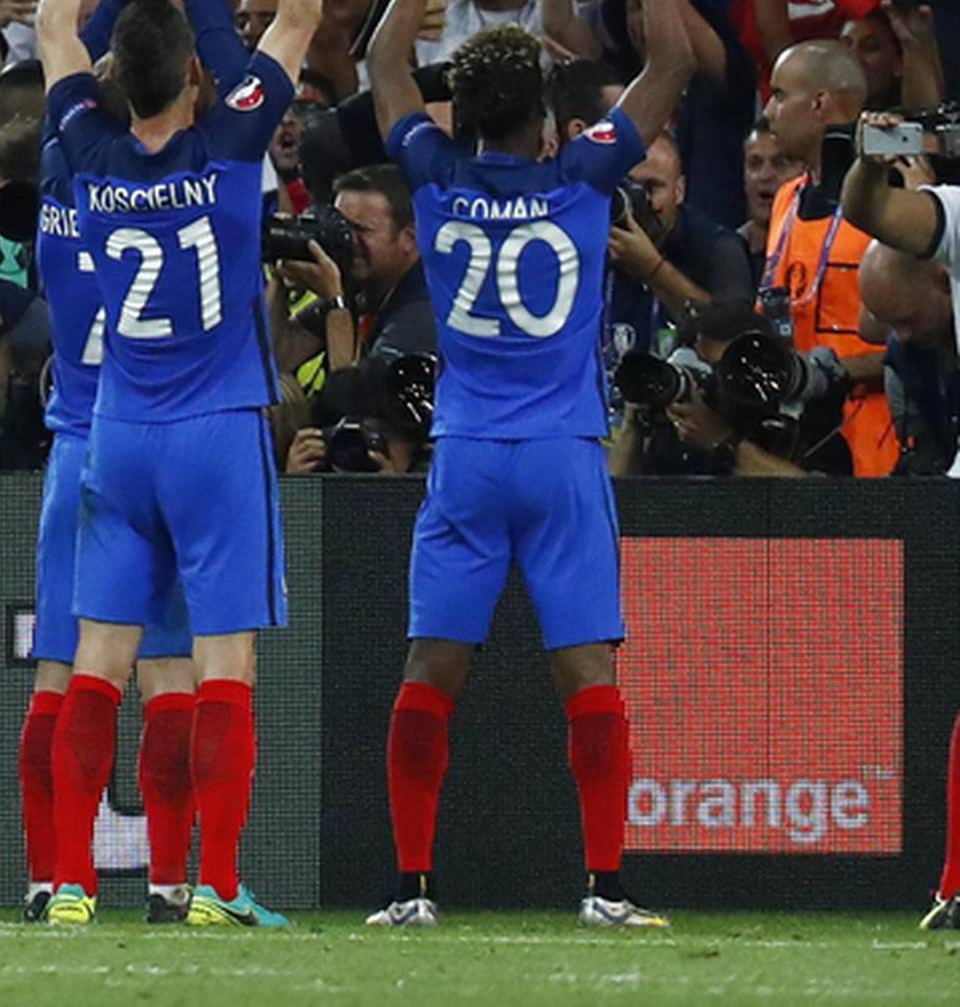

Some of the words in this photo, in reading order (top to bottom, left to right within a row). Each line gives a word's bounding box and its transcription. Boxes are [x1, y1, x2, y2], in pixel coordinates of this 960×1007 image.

[87, 173, 218, 214] KOSCIELNY
[452, 196, 549, 219] COMAN
[105, 215, 222, 339] 21
[434, 220, 580, 338] 20
[627, 778, 871, 843] orange
